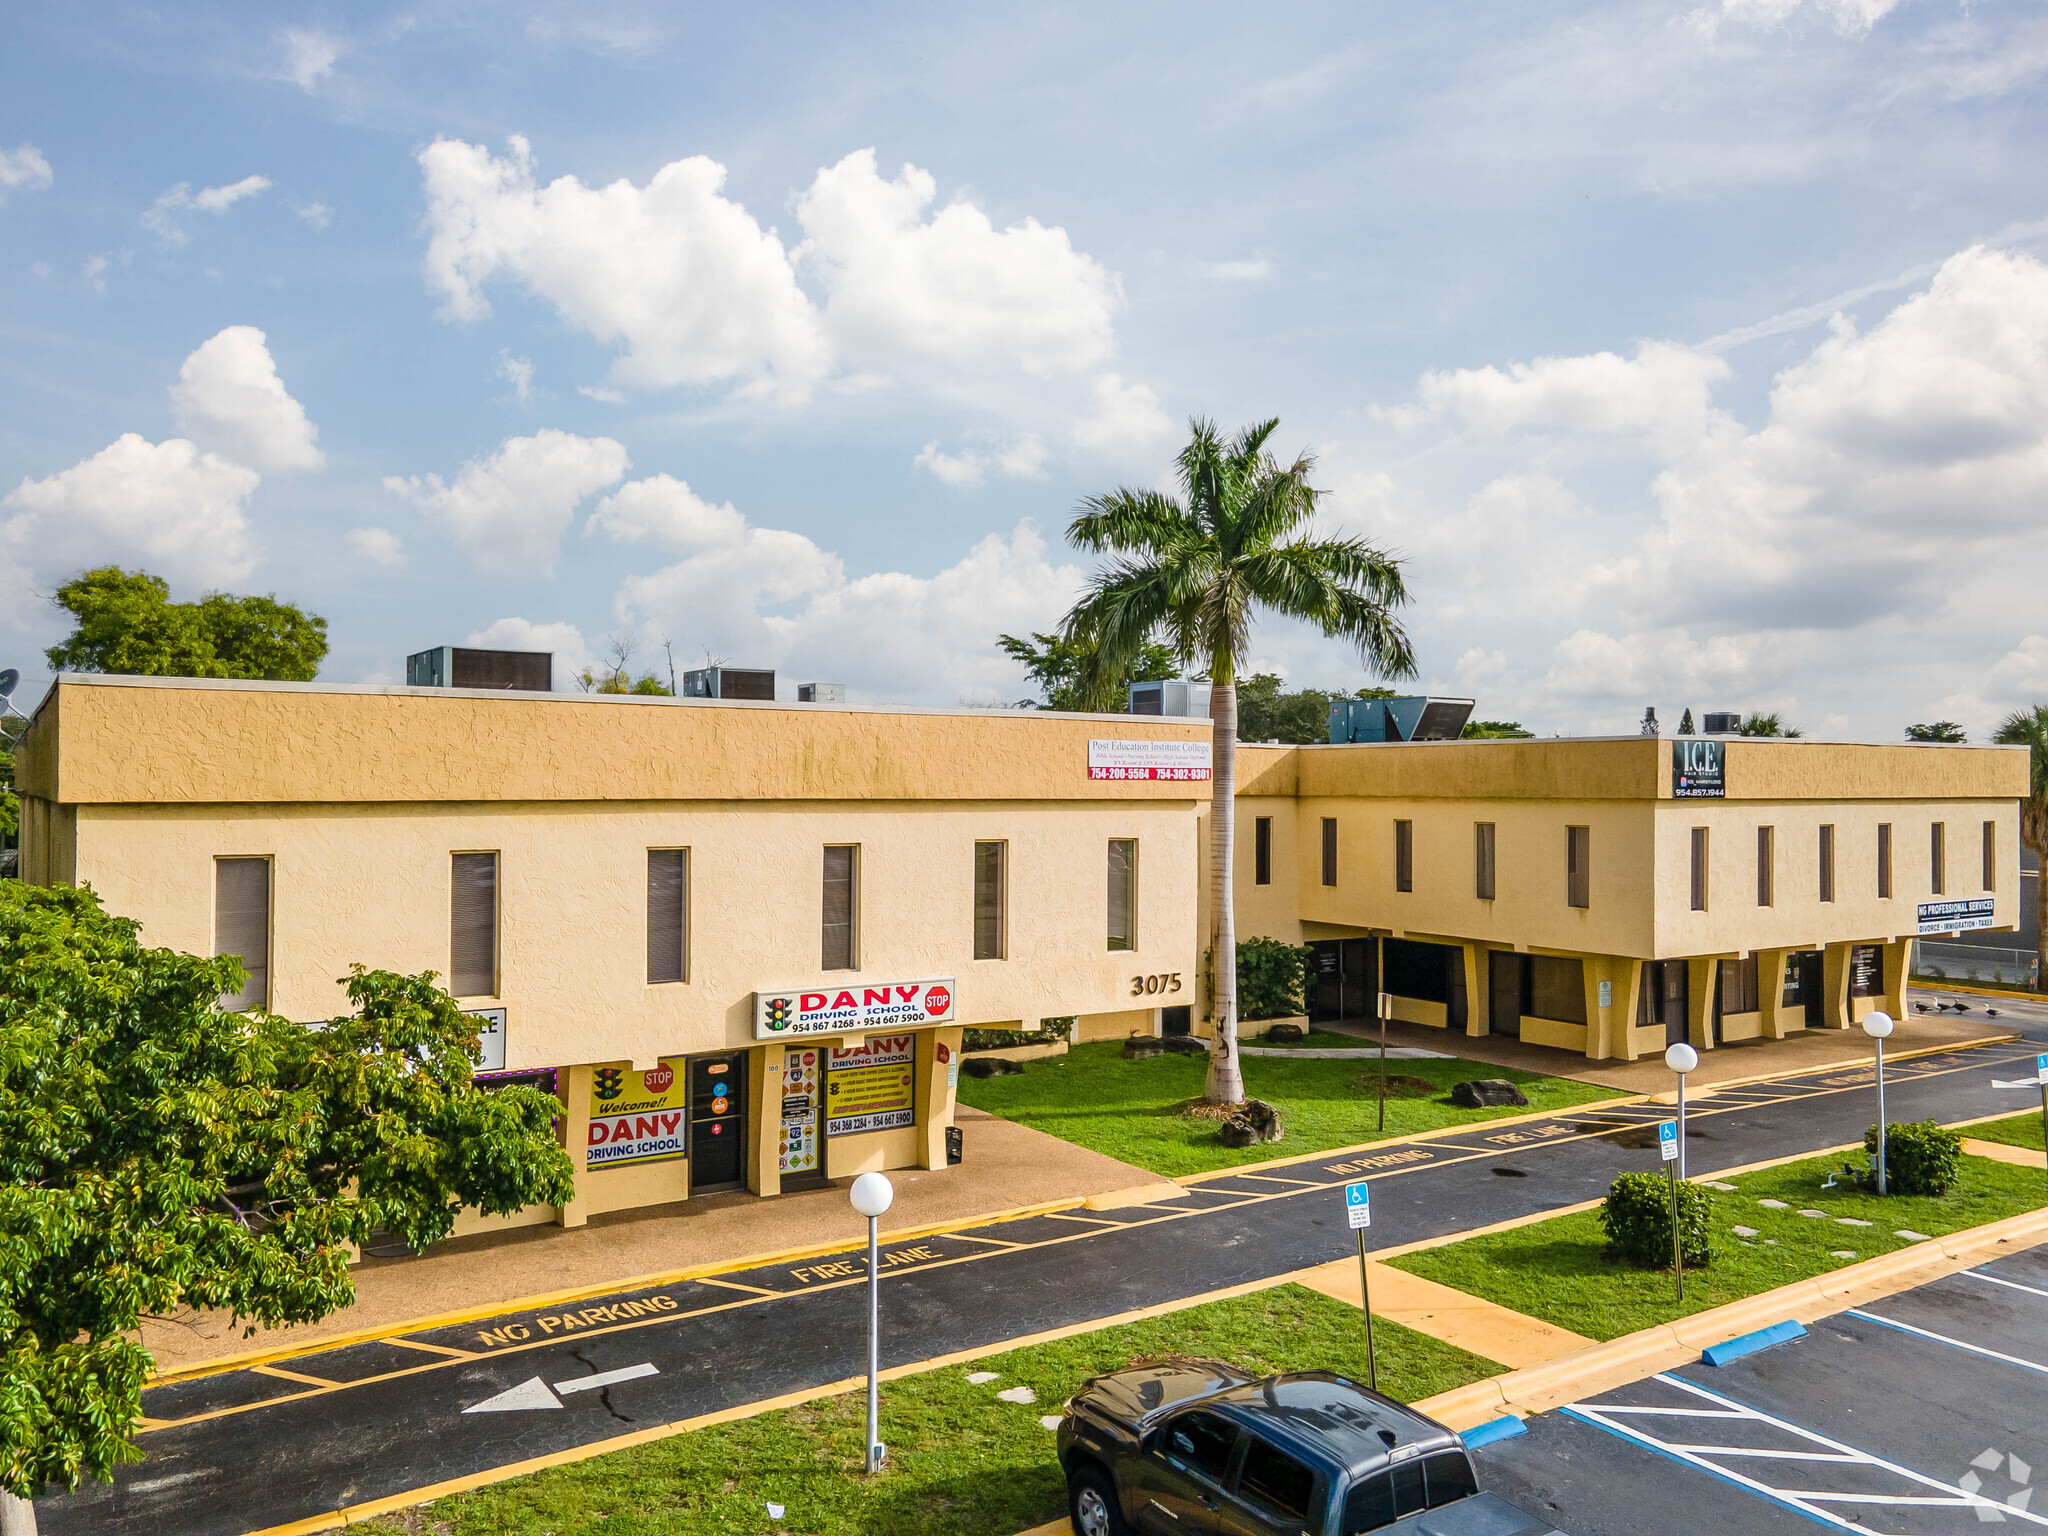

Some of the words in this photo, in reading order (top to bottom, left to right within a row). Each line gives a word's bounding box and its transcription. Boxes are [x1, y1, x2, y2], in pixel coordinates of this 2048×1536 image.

[1092, 741, 1108, 750] Post
[1111, 742, 1148, 751] Education
[1151, 742, 1180, 752] Institute
[1182, 743, 1209, 754] College
[1684, 741, 1718, 771] I.C.E.
[1091, 768, 1149, 779] 754-200-5564
[1156, 768, 1210, 779] 754-302-9301
[1675, 788, 1725, 797] 954.857.1944
[1928, 901, 1968, 915] PROFESSIONAL
[1969, 900, 1993, 911] SERVICES
[1919, 923, 1940, 933] DIVORCE
[1944, 920, 1975, 930] IMMIGRATION
[1979, 919, 1993, 927] TAXES
[1130, 973, 1182, 996] 3075
[800, 985, 919, 1012] DANY
[926, 995, 949, 1008] STOP
[792, 1023, 810, 1032] 954
[812, 1021, 829, 1031] 867
[832, 1019, 854, 1029] 4268
[864, 1017, 881, 1026] 954
[883, 1015, 899, 1024] 667
[901, 1013, 925, 1022] 5900
[800, 1010, 857, 1021] DRIVING
[866, 1005, 918, 1015] SCHOOL
[833, 1037, 910, 1059] DANY
[832, 1058, 871, 1068] DRIVING
[874, 1054, 910, 1064] SCHOOL
[645, 1071, 672, 1085] STOP
[599, 1096, 668, 1114] Welcome!!
[588, 1112, 681, 1146] DANY
[830, 1122, 841, 1132] 954
[842, 1120, 852, 1130] 368
[873, 1116, 883, 1126] 954
[885, 1114, 894, 1125] 667
[896, 1111, 911, 1123] 5900
[791, 1129, 800, 1137] 92
[1484, 1132, 1535, 1146] FIRE
[1524, 1124, 1577, 1139] LANE
[587, 1144, 634, 1160] DRIVING
[637, 1138, 681, 1153] SCHOOL
[1322, 1159, 1360, 1175] NO
[1356, 1149, 1434, 1170] PARKING
[789, 1260, 865, 1283] FIRE
[861, 1245, 944, 1268] LANE
[477, 1323, 532, 1347] NO
[536, 1295, 678, 1334] PARKING
